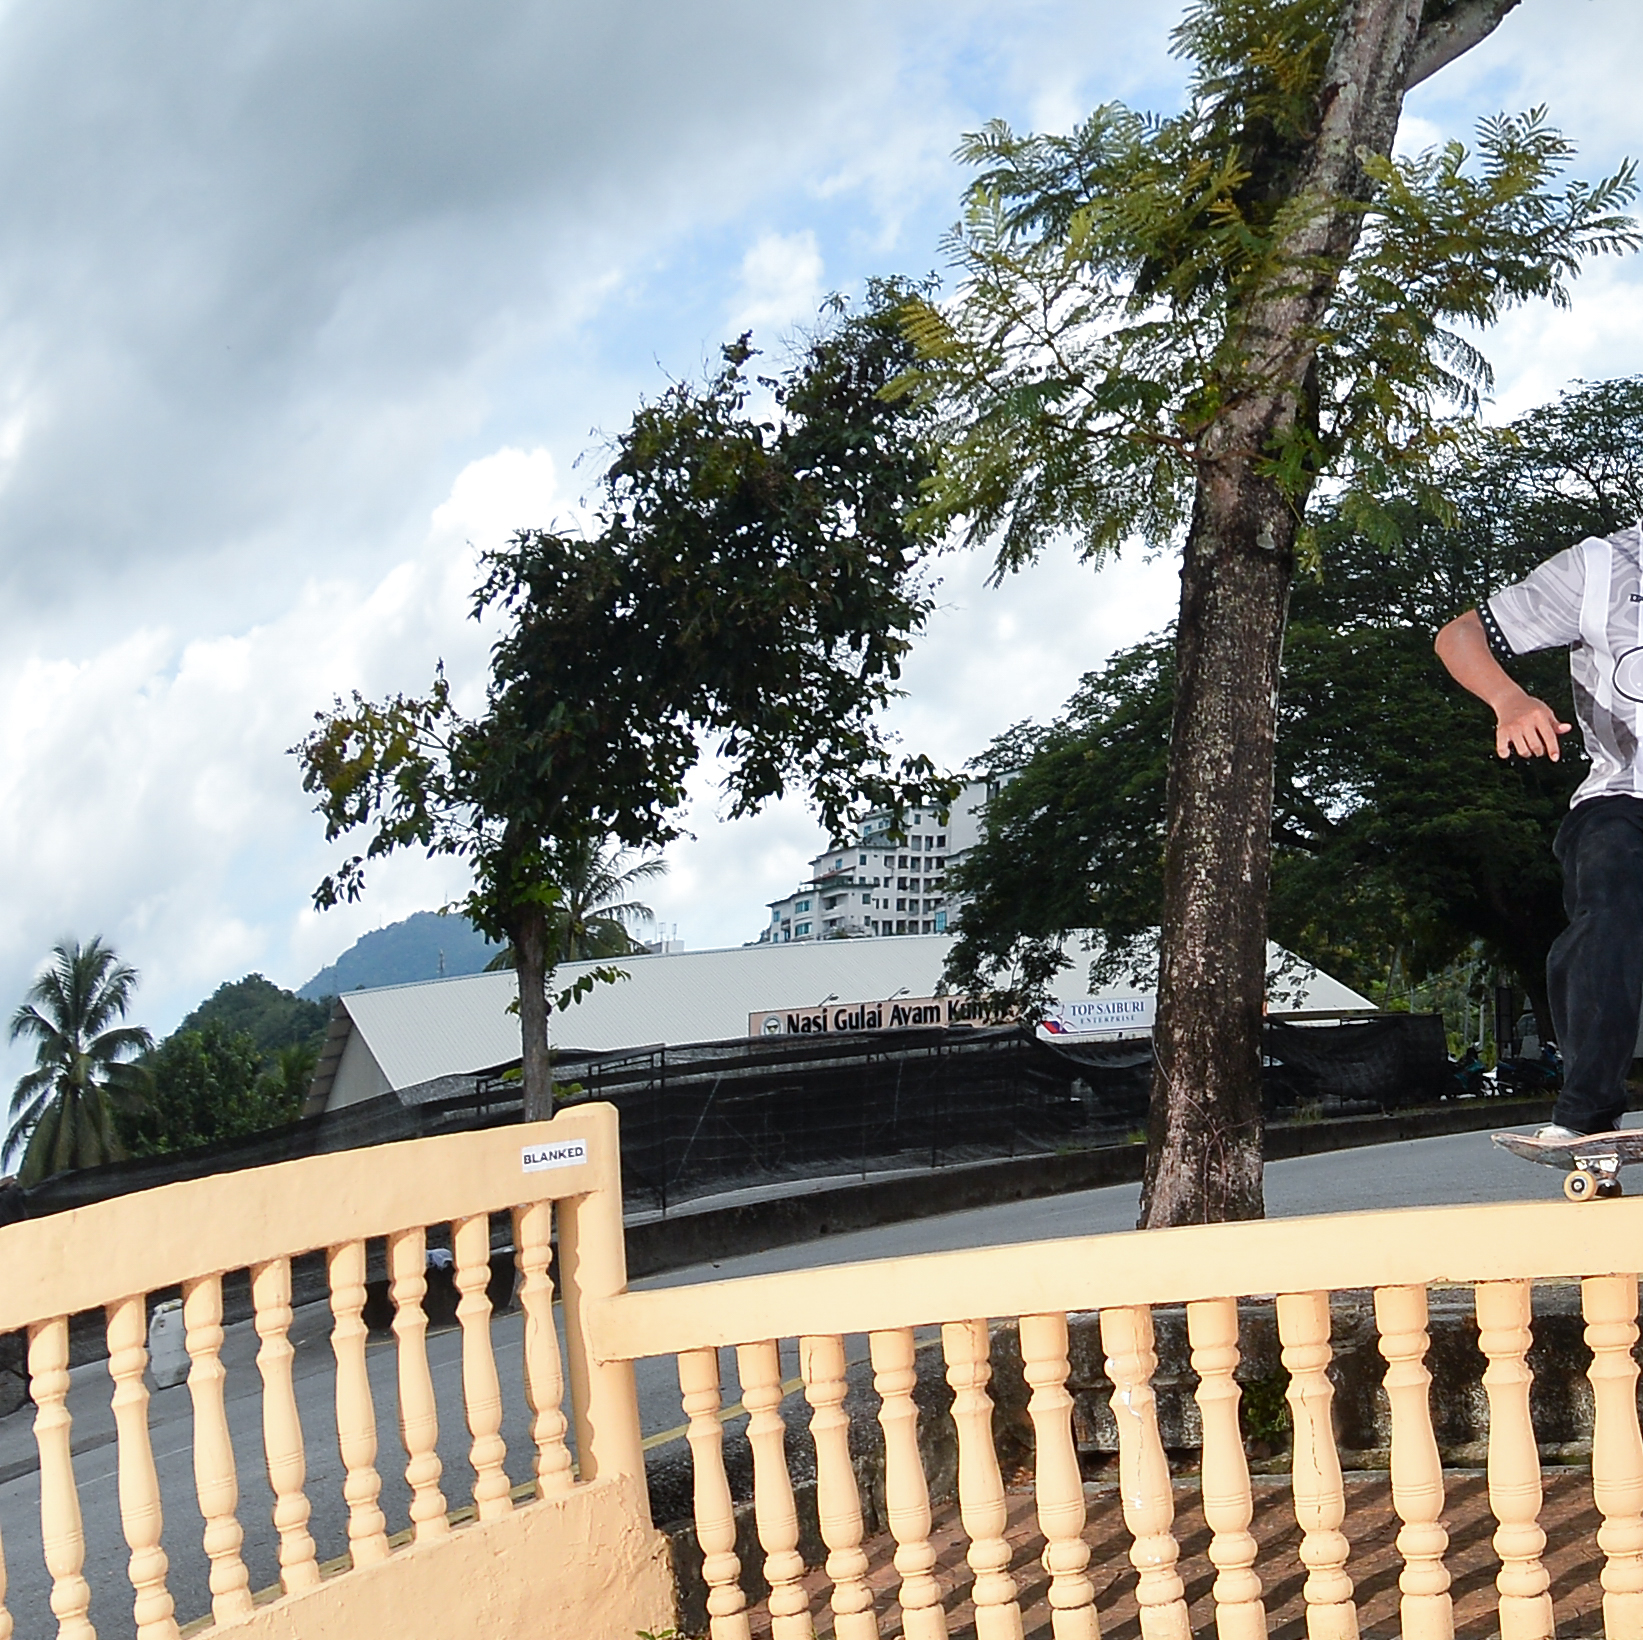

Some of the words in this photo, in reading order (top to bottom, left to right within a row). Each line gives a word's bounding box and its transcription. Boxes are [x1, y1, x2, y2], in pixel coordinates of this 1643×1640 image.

[1071, 1003, 1094, 1016] TOP
[1097, 1001, 1145, 1015] SAIBURI
[787, 1008, 828, 1034] Nasi
[834, 1003, 882, 1030] Gulai
[1080, 1014, 1135, 1024] ENTERPRISE
[523, 1146, 585, 1165] BLANKED
